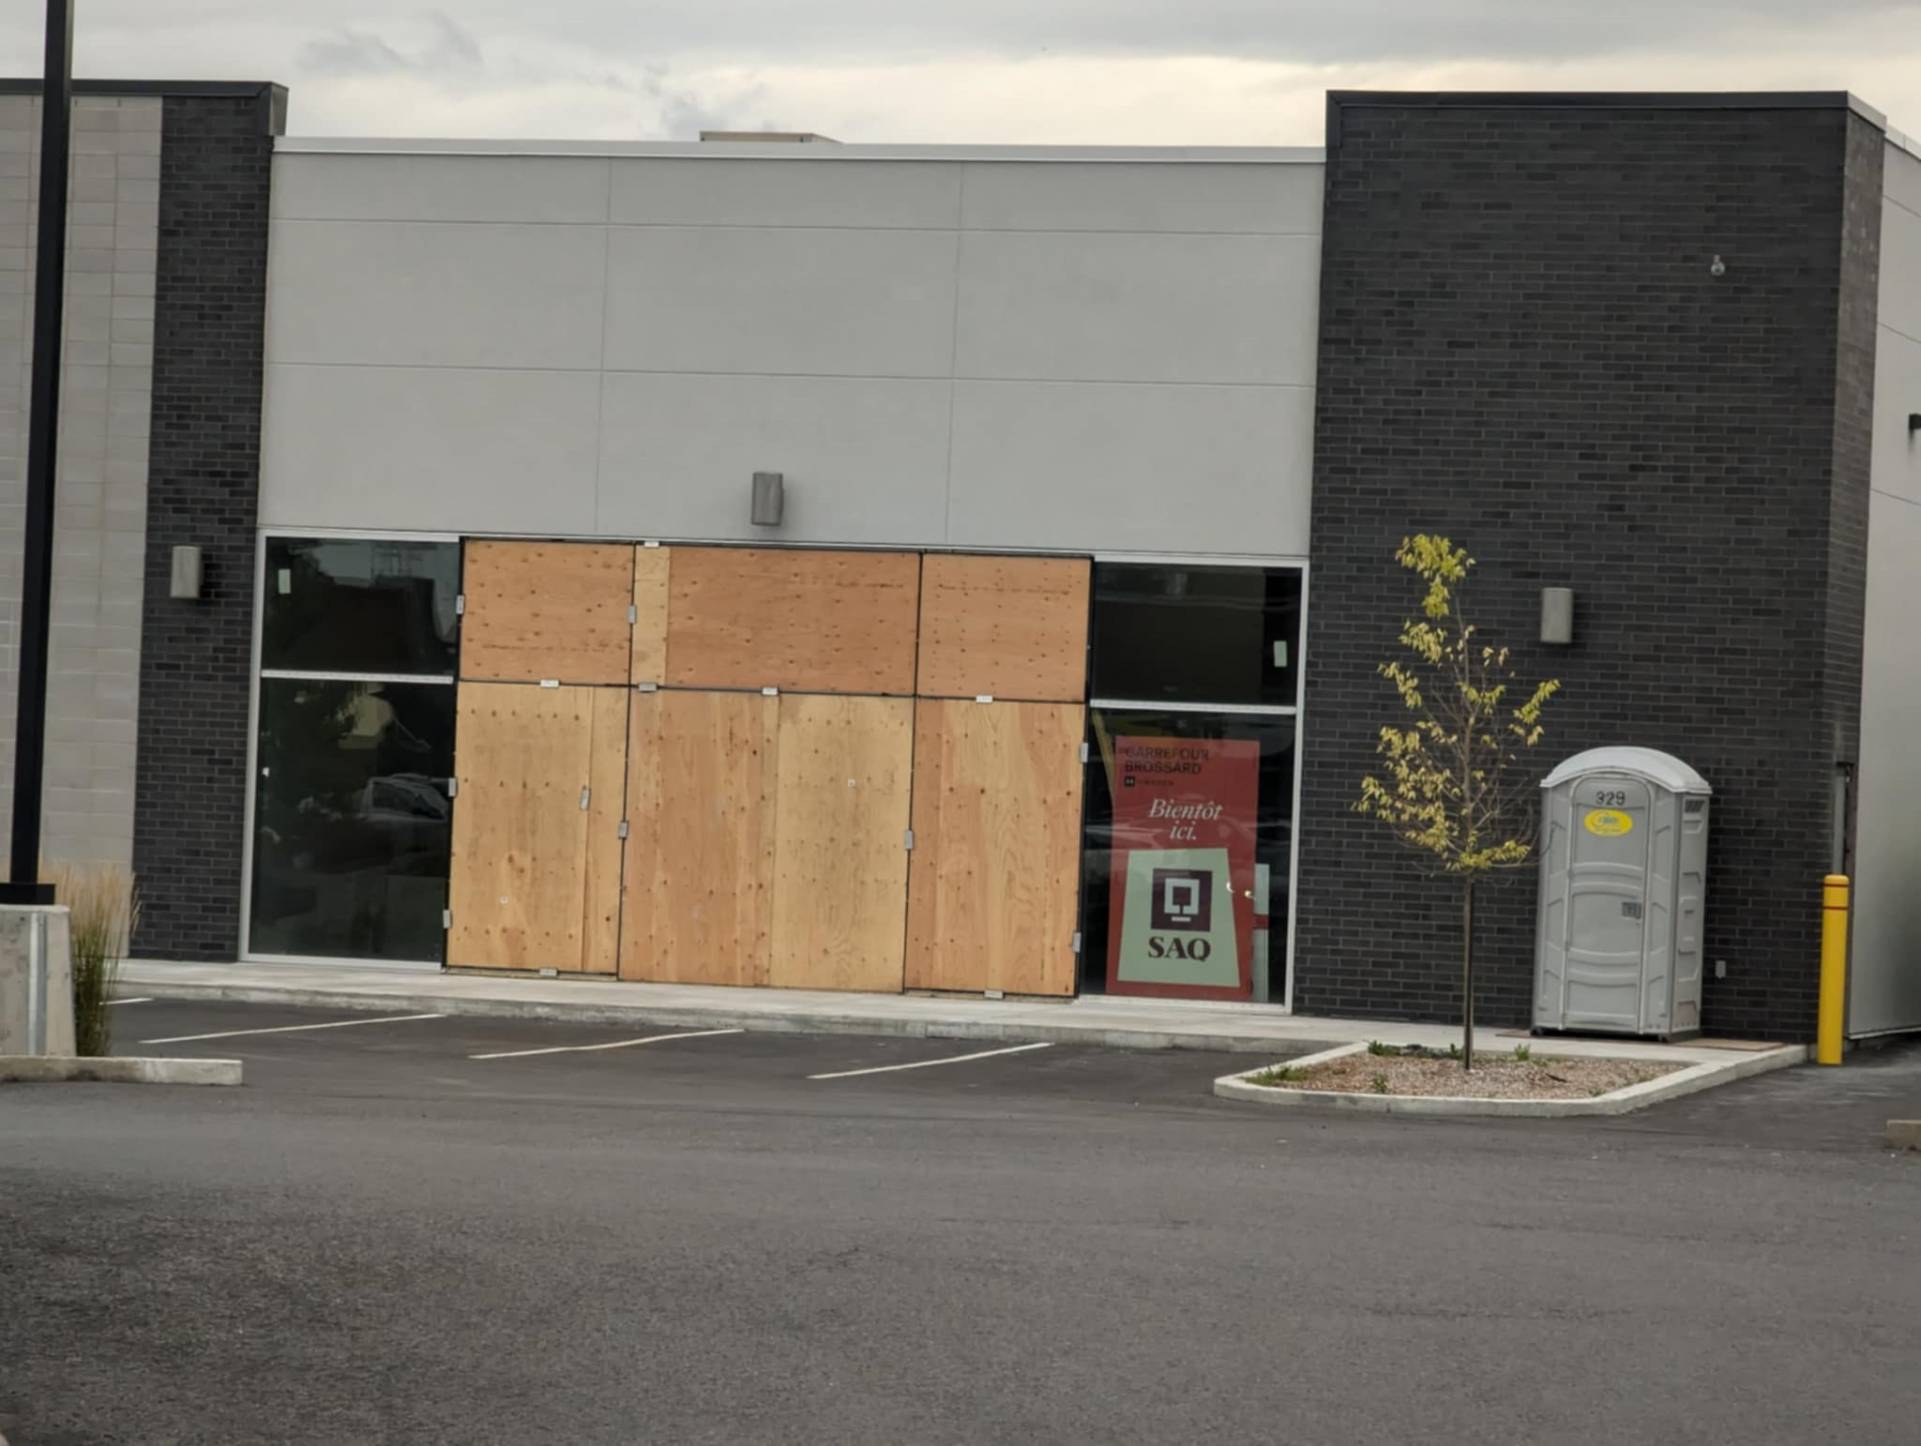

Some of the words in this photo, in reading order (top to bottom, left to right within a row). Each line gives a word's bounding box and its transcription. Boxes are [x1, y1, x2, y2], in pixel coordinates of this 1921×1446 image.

[1124, 761, 1202, 775] BROSSARD
[1596, 790, 1626, 806] 329
[1149, 798, 1223, 821] Bientôt
[1169, 820, 1198, 841] ici.
[1147, 936, 1212, 962] SAQ
